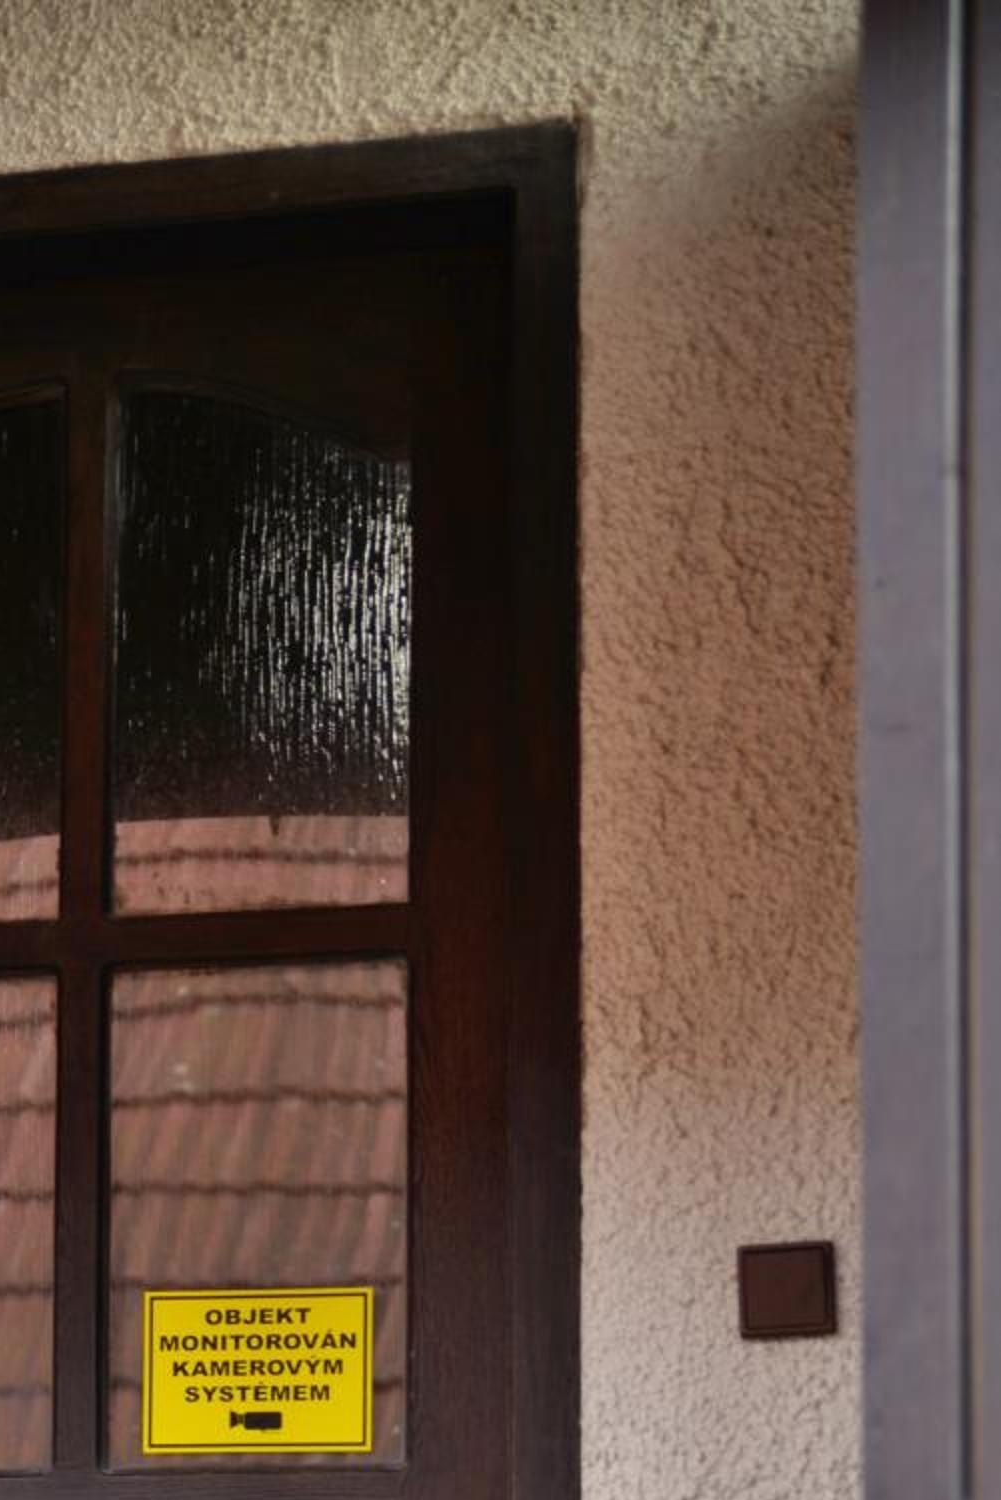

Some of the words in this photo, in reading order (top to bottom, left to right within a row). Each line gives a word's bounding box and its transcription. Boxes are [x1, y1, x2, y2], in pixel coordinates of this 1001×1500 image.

[204, 1307, 311, 1325] OBJEKT
[159, 1329, 357, 1351] MONITOROVÁN
[172, 1356, 344, 1376] KAMEROVÝM
[185, 1382, 330, 1402] SYSTÉMEM
